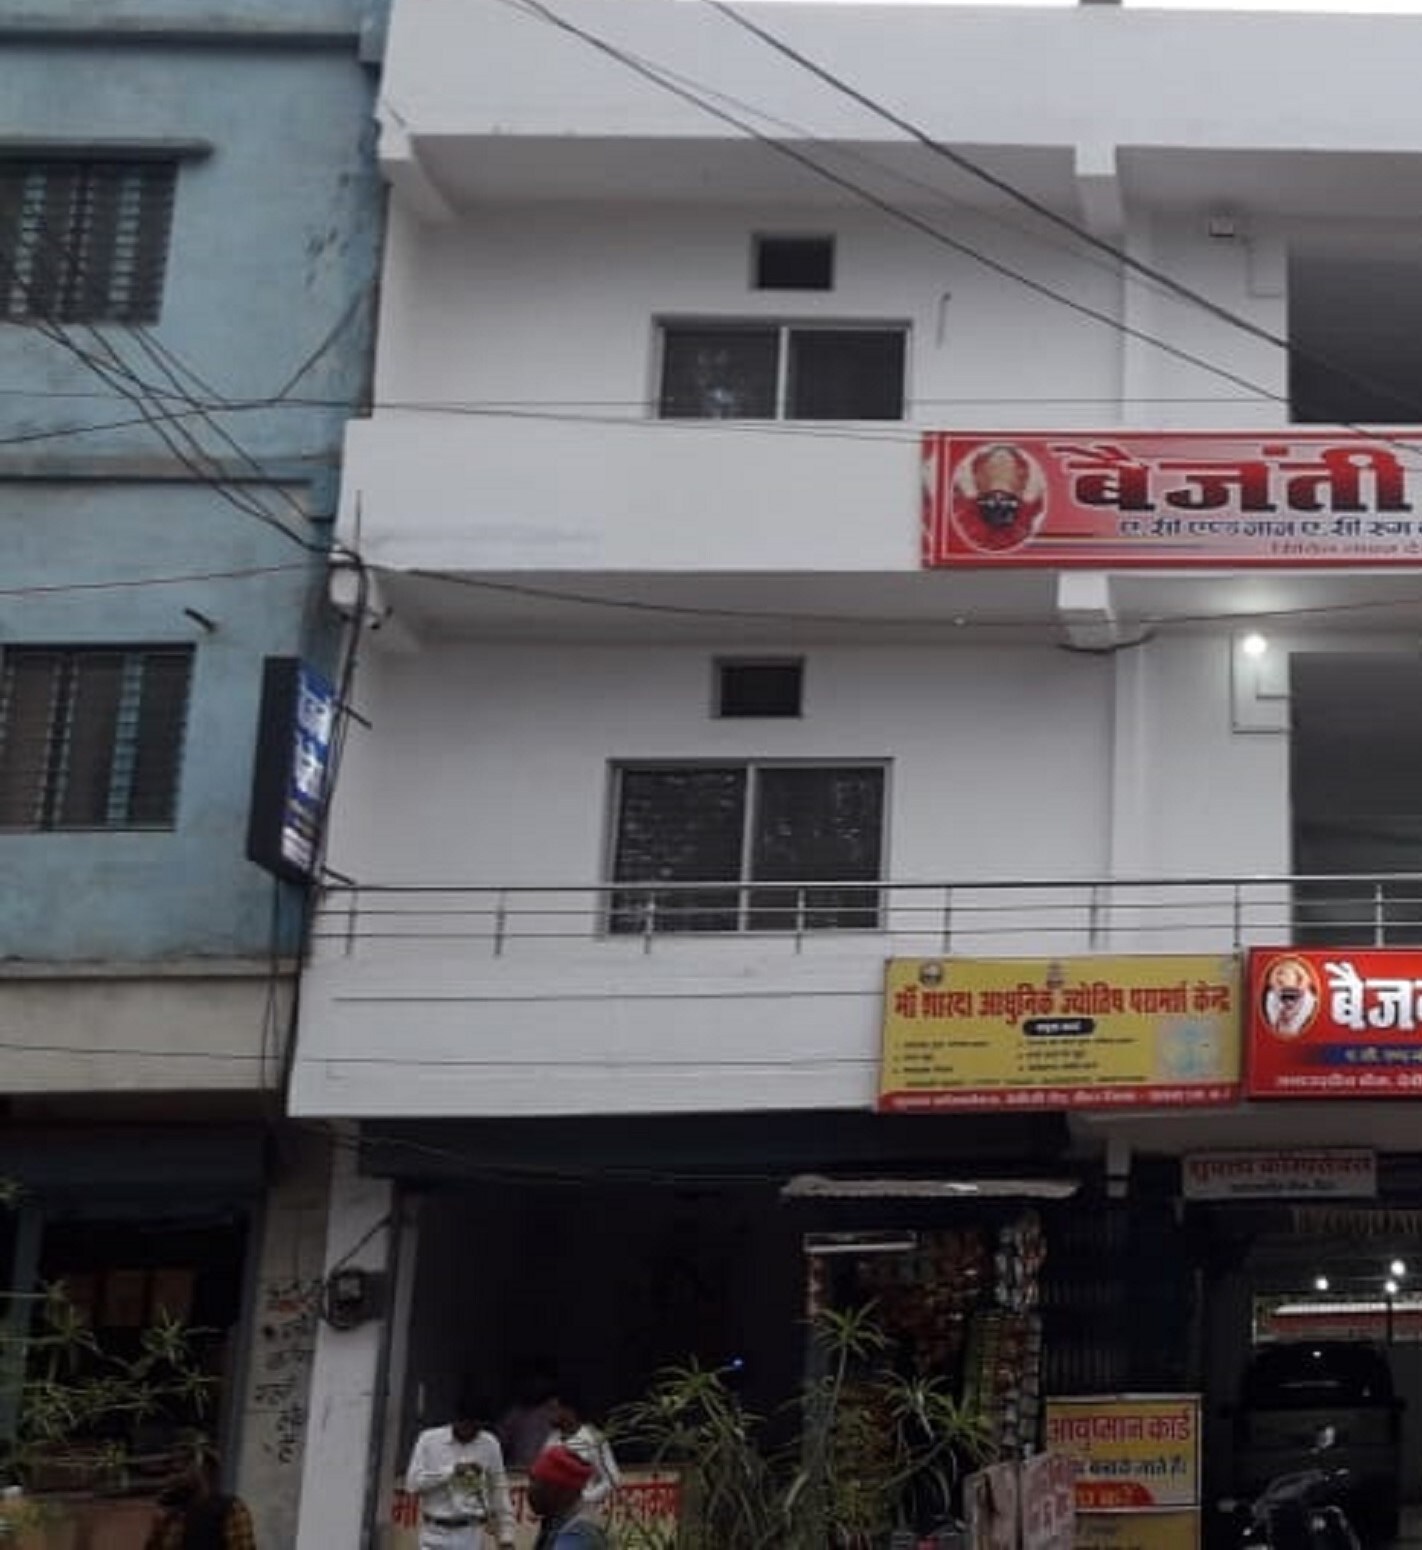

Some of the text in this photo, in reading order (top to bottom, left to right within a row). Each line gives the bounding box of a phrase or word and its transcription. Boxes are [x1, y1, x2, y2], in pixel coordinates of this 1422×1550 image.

[1052, 443, 1413, 513] बैजंती
[920, 990, 972, 1018] शारदा
[977, 983, 1053, 1025] आधुनिक
[1060, 980, 1126, 1015] ज्योतिष
[1130, 980, 1188, 1014] परामर्श
[1147, 1407, 1191, 1440] कार्ड
